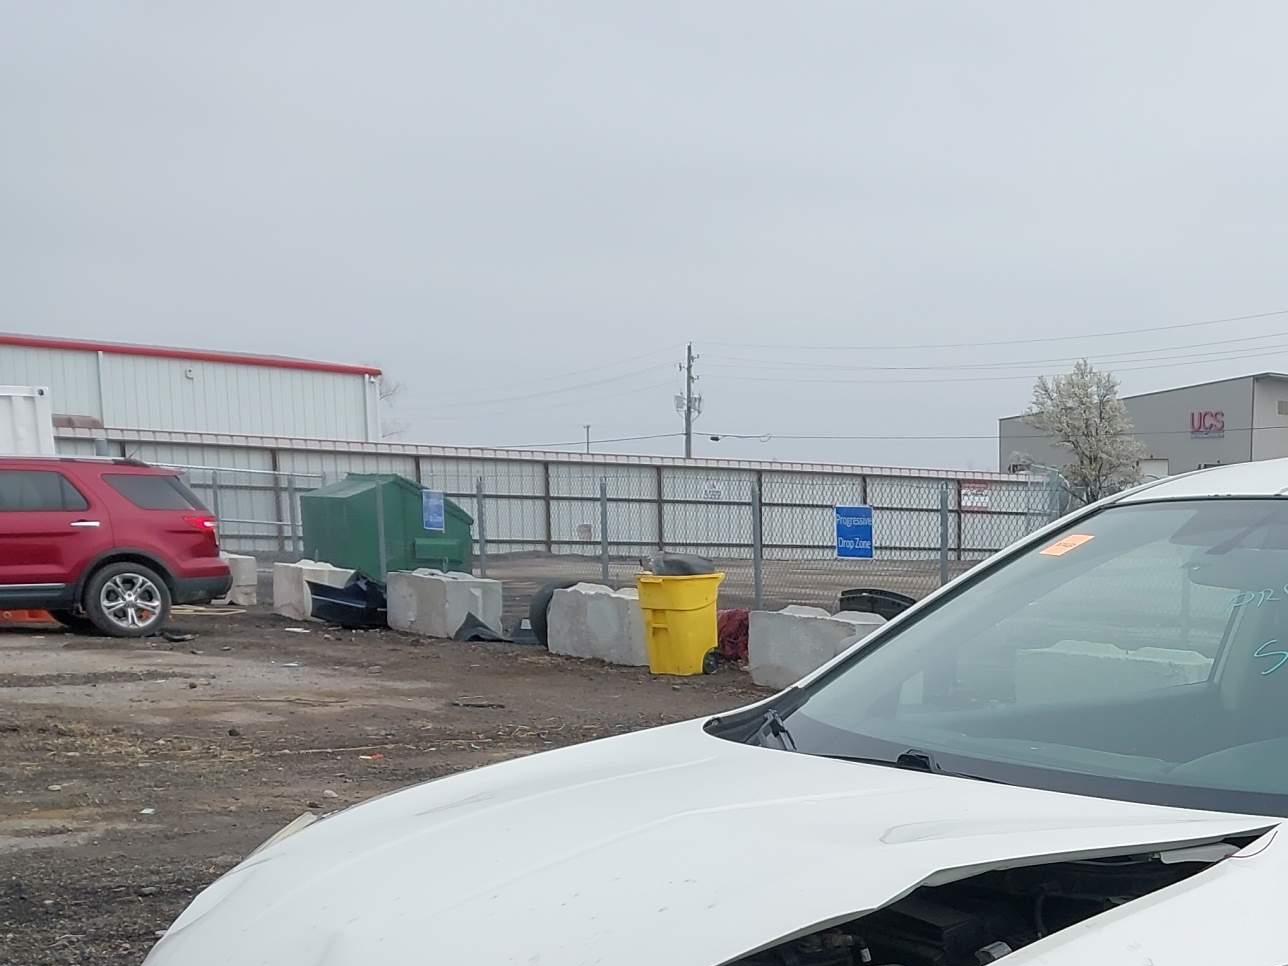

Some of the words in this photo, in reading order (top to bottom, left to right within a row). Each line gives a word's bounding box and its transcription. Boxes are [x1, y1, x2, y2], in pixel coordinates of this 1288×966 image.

[1191, 411, 1225, 431] UCS
[836, 513, 872, 528] Progressive
[838, 537, 854, 550] Drop
[855, 537, 871, 549] Zone
